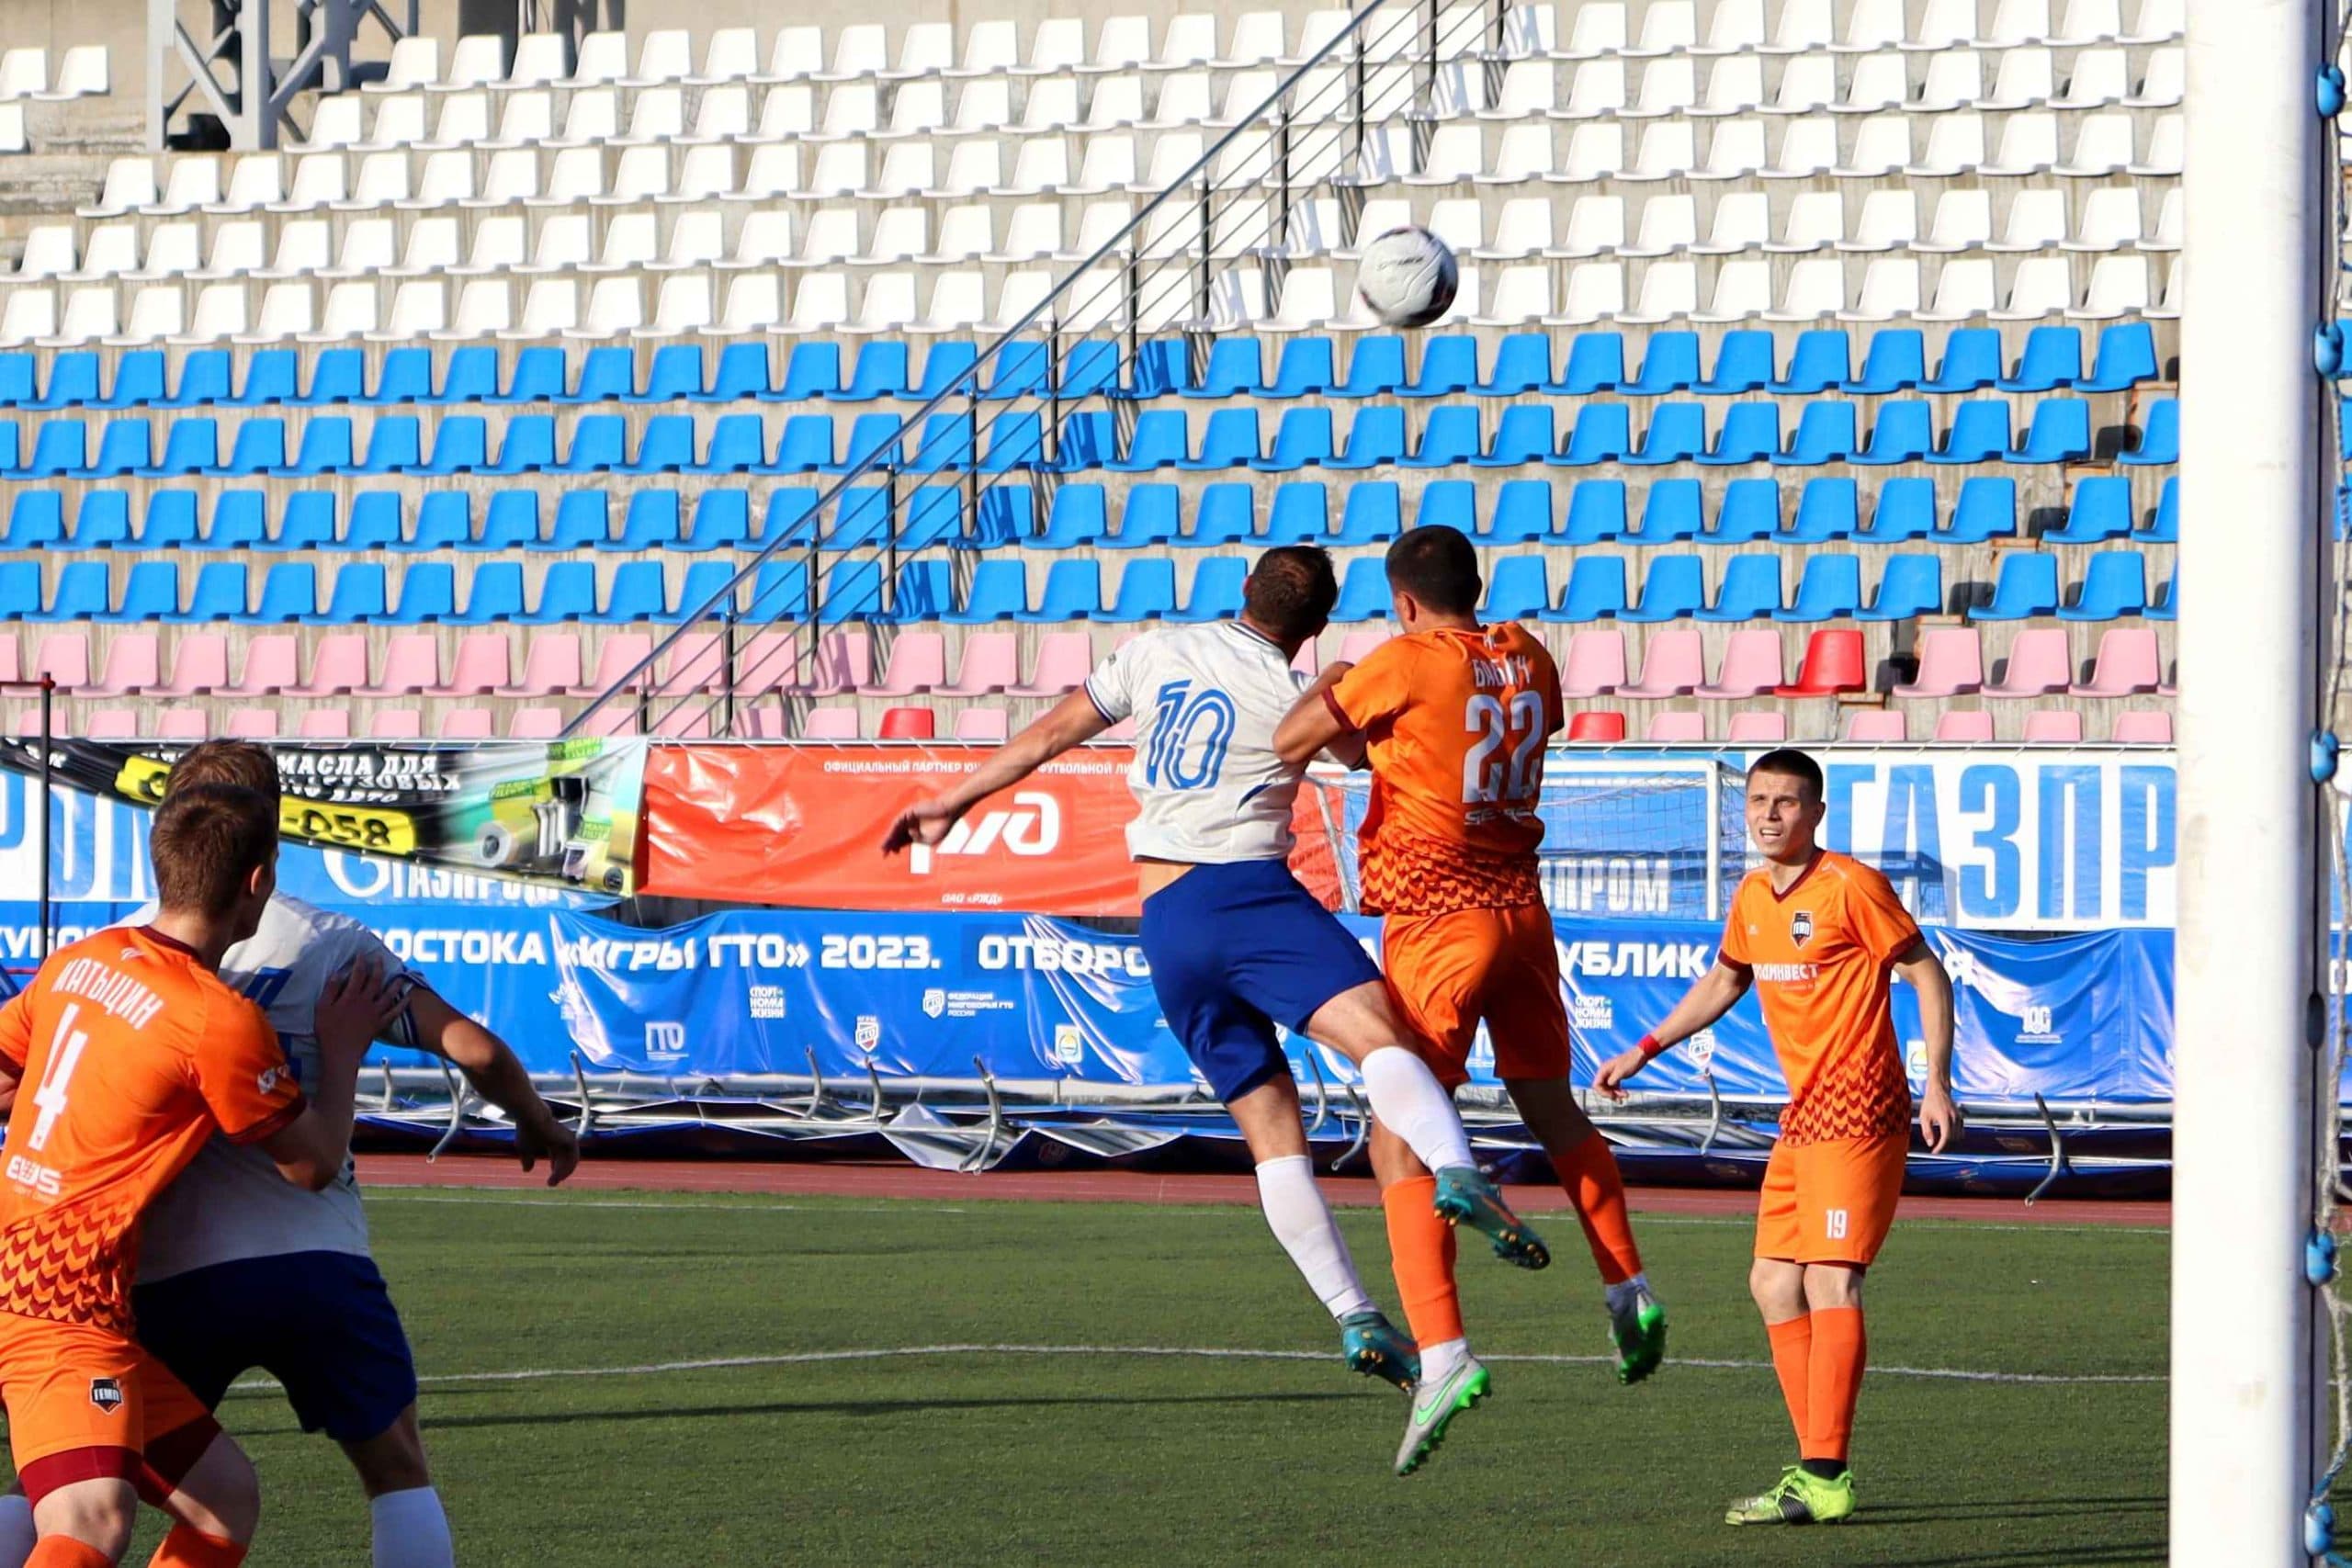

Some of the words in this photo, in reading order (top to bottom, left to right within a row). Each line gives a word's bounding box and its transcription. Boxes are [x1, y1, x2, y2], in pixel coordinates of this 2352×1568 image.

[1146, 679, 1236, 791] 10
[1462, 690, 1544, 804] 22
[277, 753, 372, 775] МАСЛА
[379, 755, 437, 776] ДЛЯ
[823, 761, 910, 774] ОФИЦИАЛЬНЫЙ
[912, 761, 961, 773] ПАРТНЕР
[1038, 761, 1113, 774] ФУТБОЛЬНОЙ
[369, 928, 547, 964] ОСТОКА
[708, 934, 810, 968] ГТО»
[821, 935, 942, 969] 2023.
[1555, 941, 1719, 978] УБЛИК
[645, 1021, 684, 1051] ГТО
[29, 1003, 88, 1151] 4
[1826, 1209, 1847, 1239] 19
